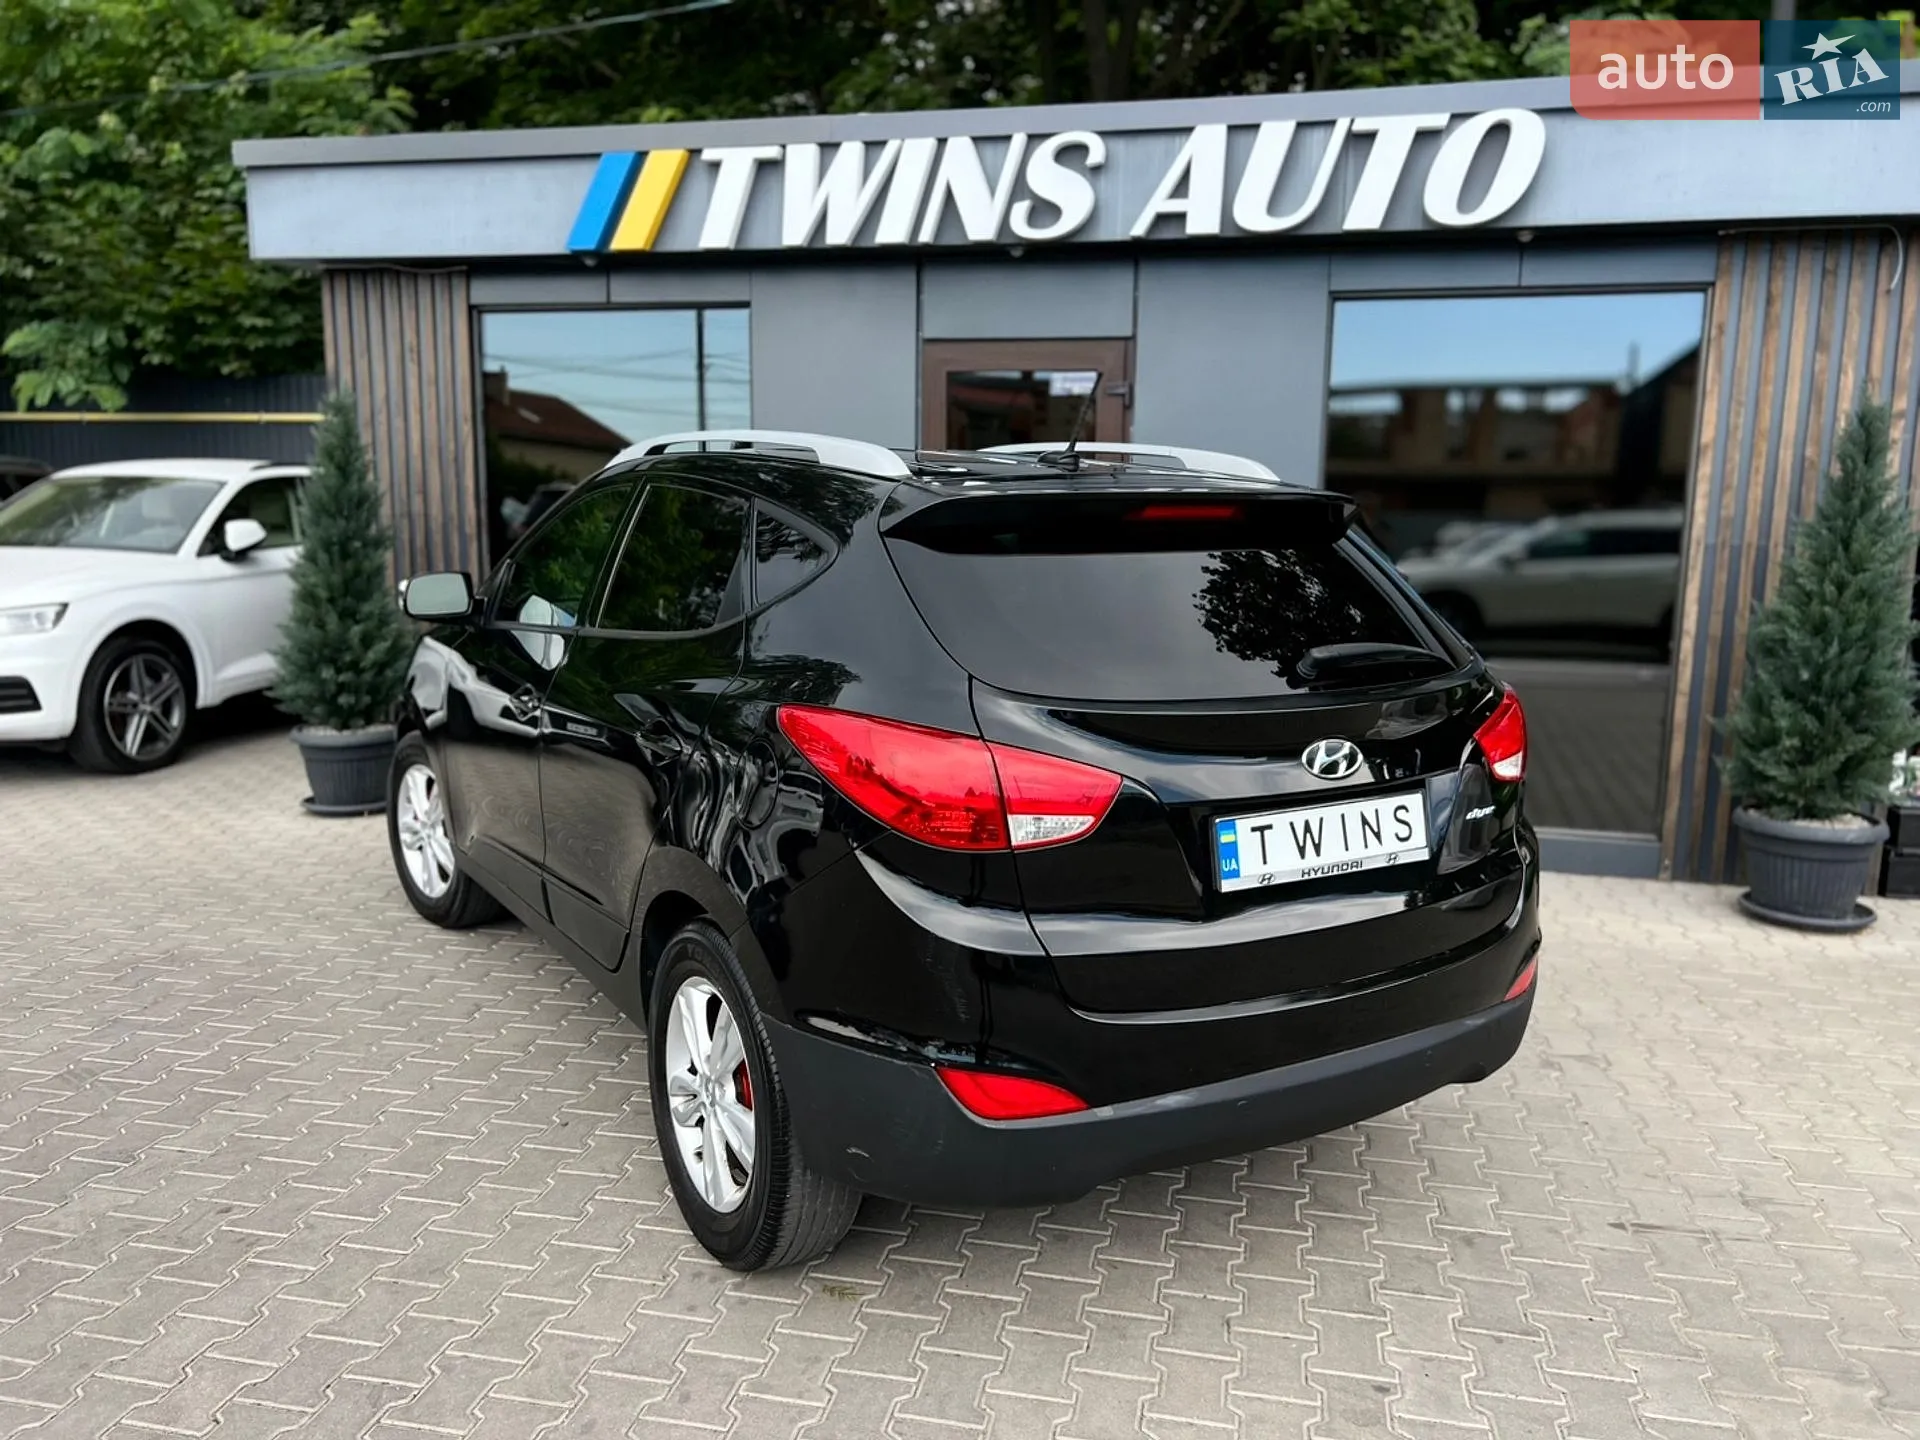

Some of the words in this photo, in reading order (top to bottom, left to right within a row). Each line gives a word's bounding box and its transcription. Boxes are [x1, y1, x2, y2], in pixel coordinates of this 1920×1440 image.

[698, 130, 1106, 250] TWINS
[1130, 108, 1547, 237] AUTO
[1222, 859, 1238, 872] UA
[1300, 861, 1363, 879] HYUNDAI
